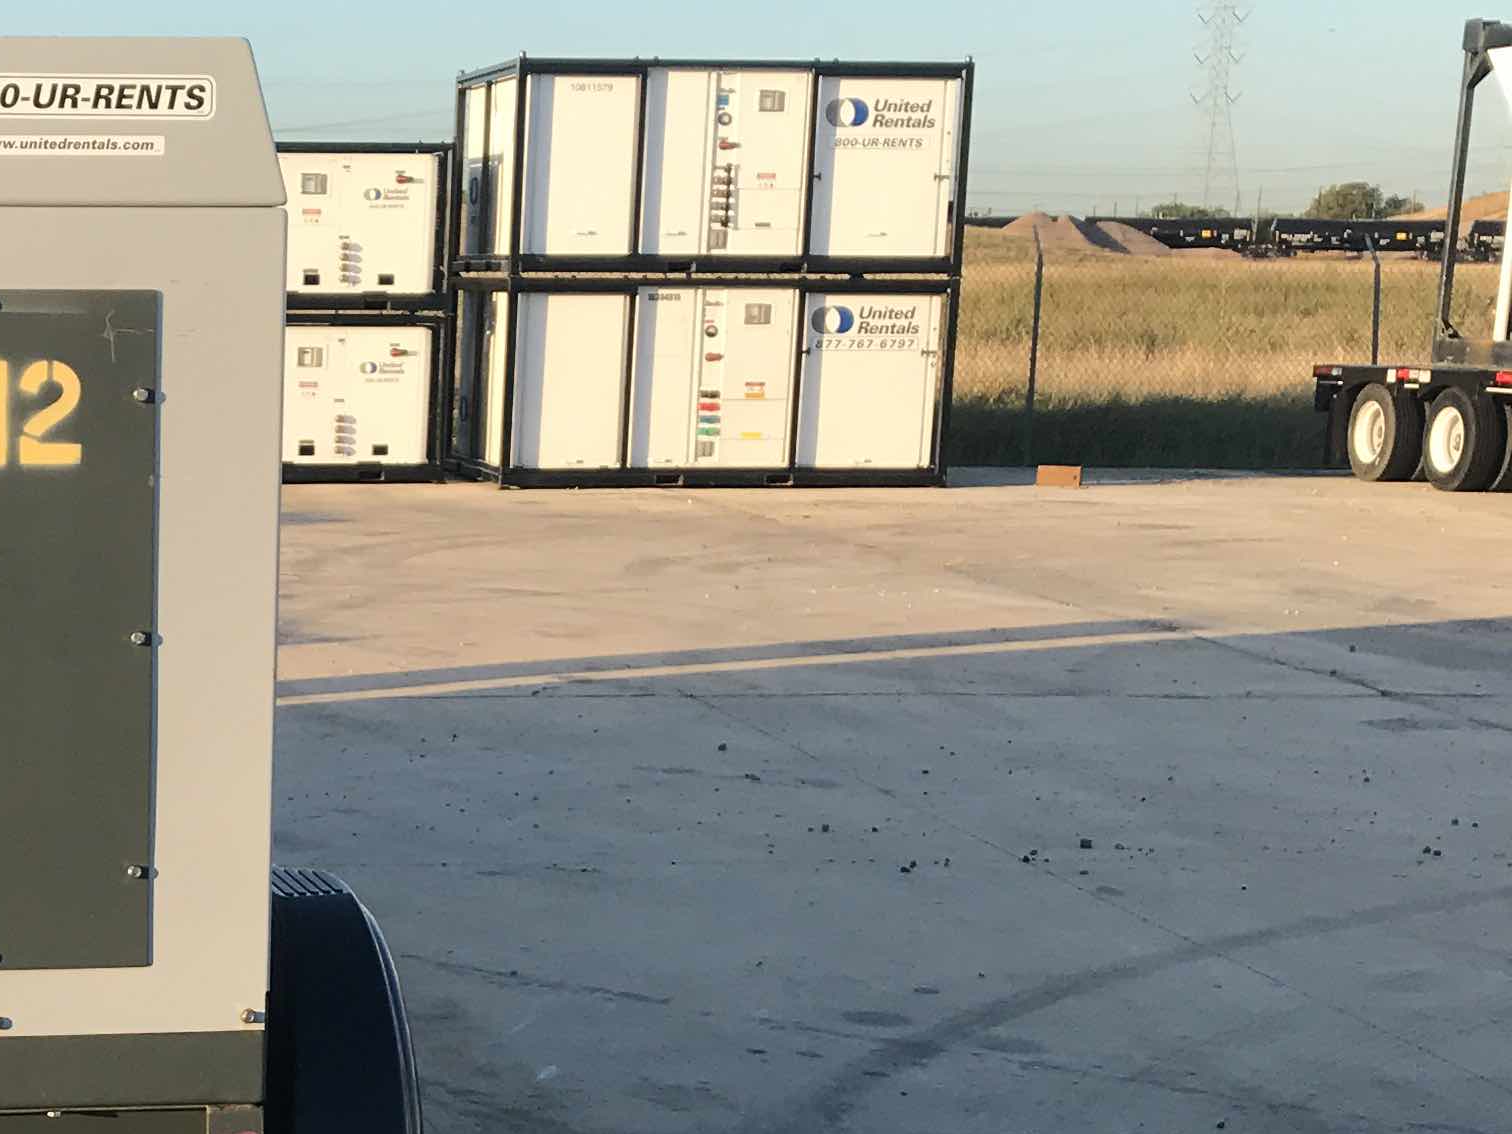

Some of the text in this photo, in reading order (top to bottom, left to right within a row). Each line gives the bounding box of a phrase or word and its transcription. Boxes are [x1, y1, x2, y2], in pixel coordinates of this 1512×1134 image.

[873, 98, 933, 113] United
[871, 114, 937, 129] Rentals
[858, 306, 917, 320] United
[857, 321, 920, 335] Rentals
